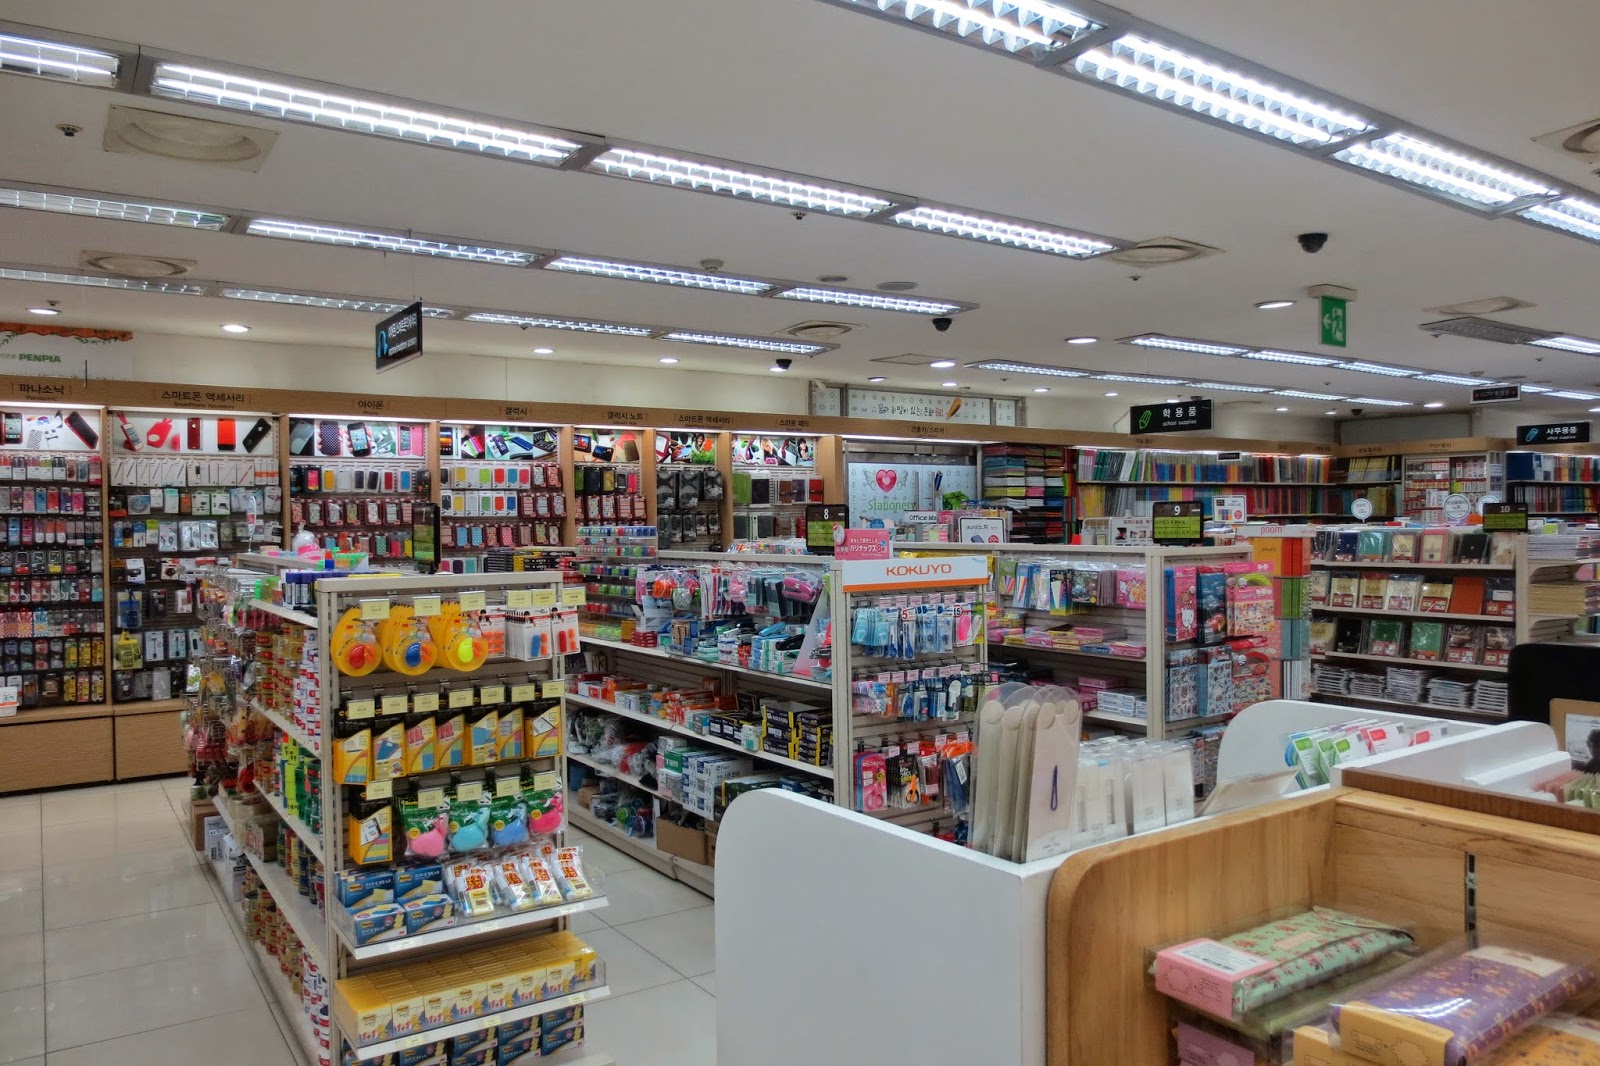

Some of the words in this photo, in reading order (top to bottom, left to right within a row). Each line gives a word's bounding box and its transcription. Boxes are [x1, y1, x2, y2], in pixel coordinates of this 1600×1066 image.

[19, 353, 61, 363] PENPIA
[18, 383, 64, 395] 파나소닉
[161, 390, 202, 402] 스마트폰
[205, 392, 245, 403] 액세서리
[358, 400, 384, 410] 아이폰
[505, 407, 527, 416] 갤럭시
[608, 411, 628, 420] 갤럭시
[630, 412, 643, 420] 노트
[678, 415, 704, 423] 스마트폰
[1546, 426, 1577, 435] 사무용품
[868, 499, 915, 512] Stationery
[1174, 505, 1181, 516] 9
[1500, 505, 1510, 513] 10
[823, 508, 829, 519] 8
[1260, 526, 1283, 536] poom
[886, 563, 952, 577] KOKUYO
[902, 609, 909, 619] 5
[549, 982, 562, 993] 1+1
[520, 990, 534, 1002] 1+1
[490, 998, 504, 1009] 1+1
[459, 1004, 473, 1016] 1+1
[428, 1012, 443, 1025] 1+1
[396, 1020, 411, 1032] 1+1
[361, 1029, 377, 1041] 1+1
